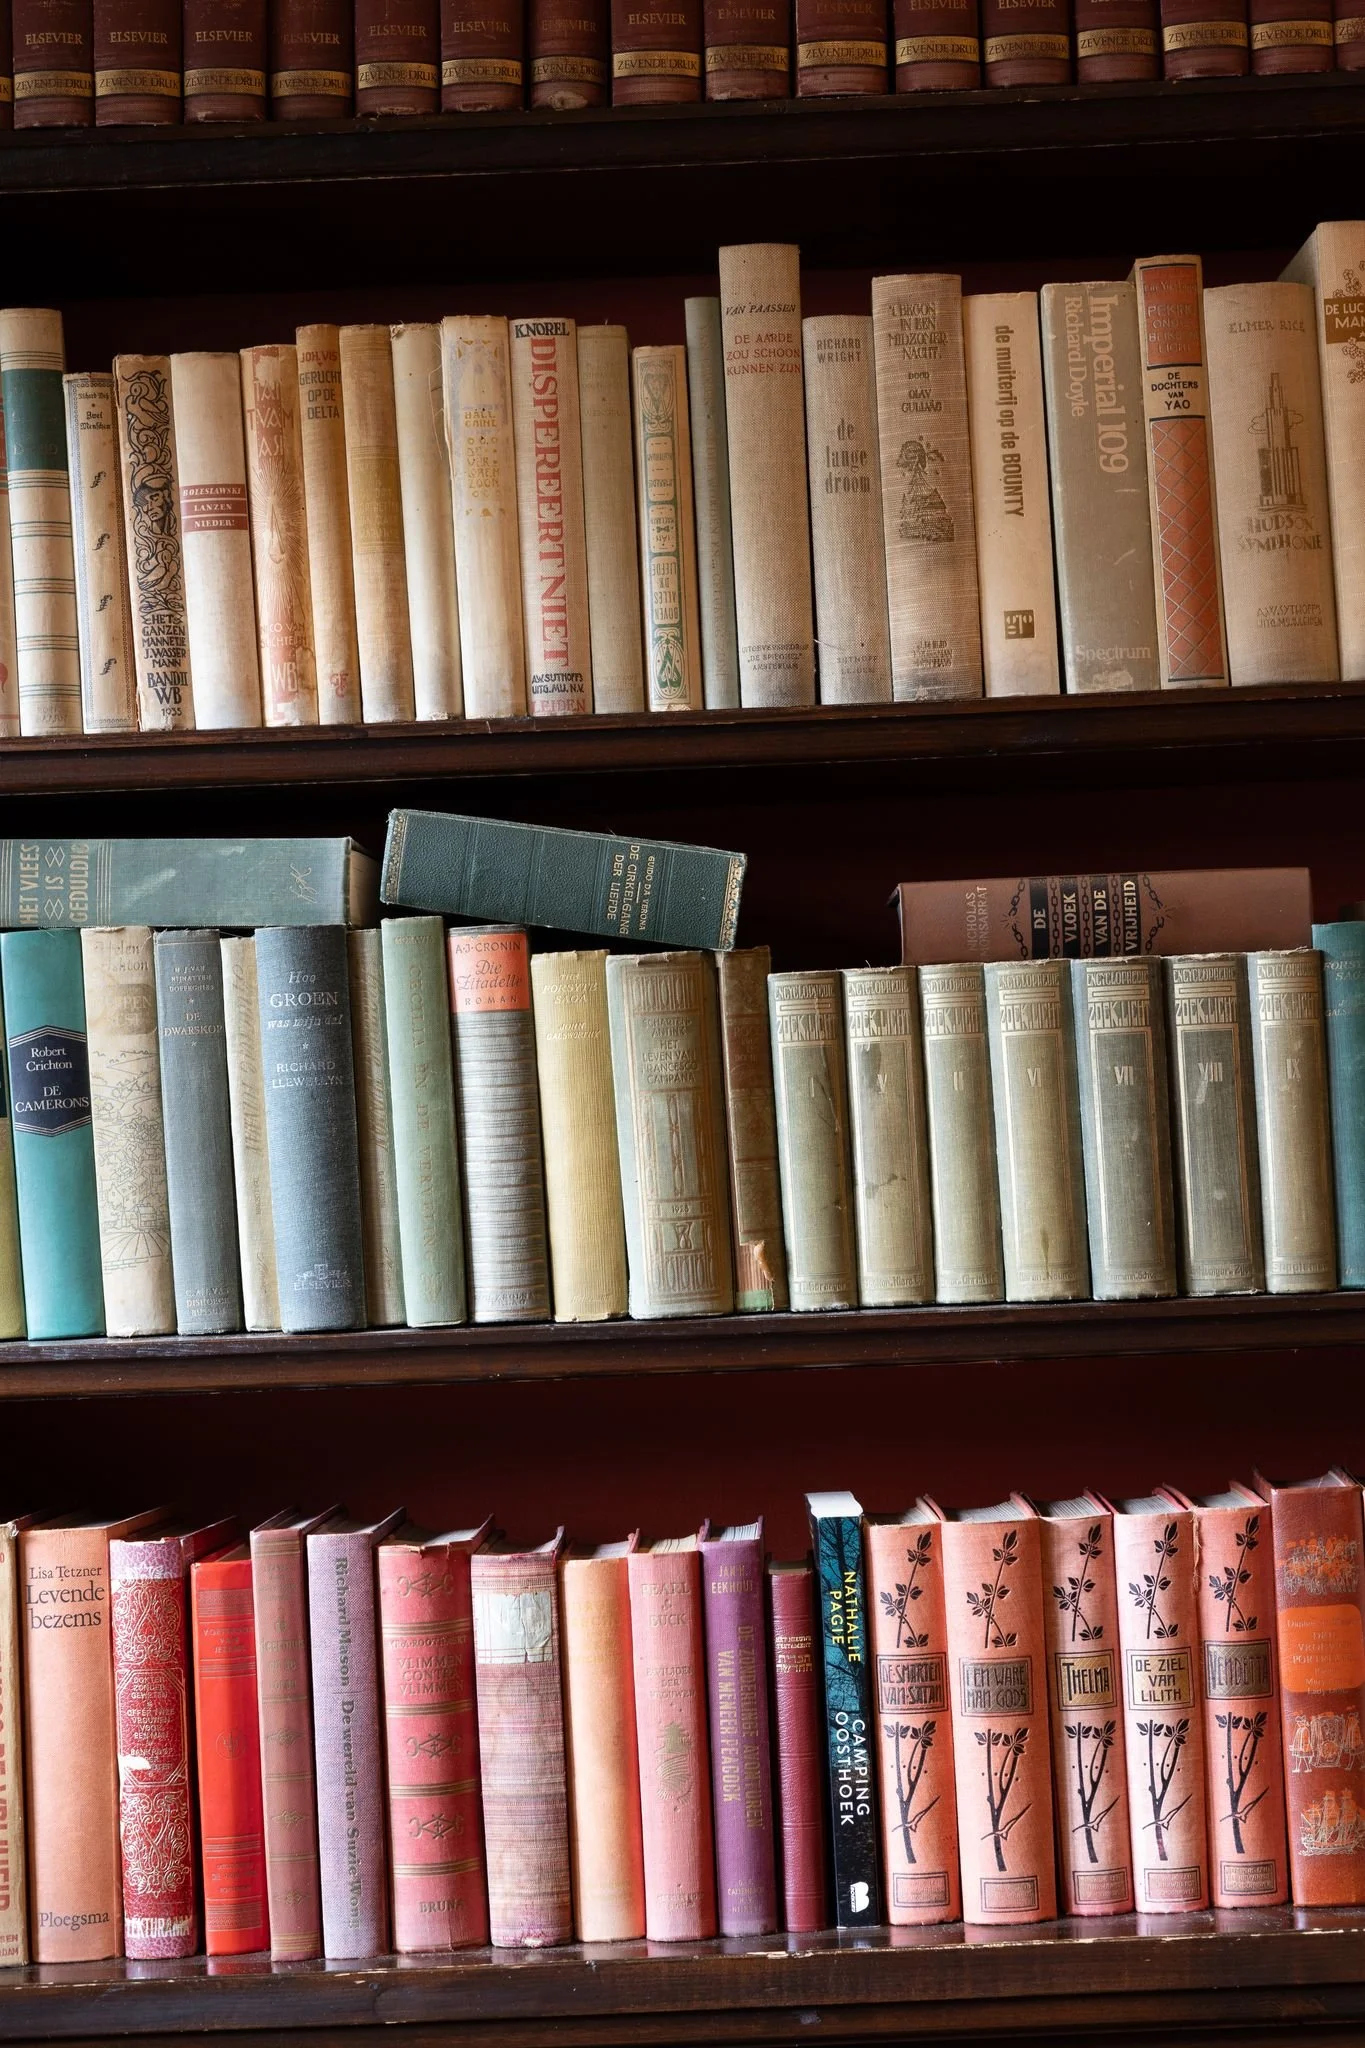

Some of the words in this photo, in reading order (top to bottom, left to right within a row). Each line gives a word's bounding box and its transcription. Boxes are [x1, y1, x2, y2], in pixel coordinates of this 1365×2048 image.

[628, 14, 686, 26] ELSEVIER
[718, 9, 776, 20] ELSEVIER
[370, 25, 427, 37] ELSEVIER
[453, 21, 511, 33] ELSEVIER
[542, 20, 596, 32] ELSEVIER
[25, 32, 82, 45] ELSEVIER
[110, 32, 167, 44] ELSEVIER
[196, 31, 253, 43] ELSEVIER
[283, 33, 340, 45] ELSEVIER
[708, 53, 756, 66] ZEVENDE
[758, 54, 786, 67] DRUK
[855, 47, 884, 59] DRUK
[443, 66, 491, 79] ZEVENDE
[493, 66, 521, 79] DRUK
[618, 58, 669, 71] ZEVENDE
[670, 59, 698, 71] DRUK
[16, 79, 62, 92] ZEVENDE
[100, 78, 149, 91] ZEVENDE
[151, 79, 178, 91] DRUK
[186, 76, 234, 90] ZEVENDE
[236, 76, 264, 88] DRUK
[360, 71, 406, 84] ZEVENDE
[409, 71, 438, 85] DRUK
[727, 304, 746, 315] VAN
[750, 303, 797, 313] PAASSEN
[1325, 304, 1340, 316] DE
[901, 318, 912, 330] IN
[1064, 295, 1087, 365] Richard
[1229, 320, 1273, 334] ELMER
[515, 323, 570, 343] KNOREL
[734, 334, 751, 344] DE
[756, 332, 793, 343] AARDE
[995, 325, 1014, 343] de
[817, 338, 861, 351] RICHARD
[726, 350, 749, 360] ZOU
[754, 348, 800, 358] SCHOON
[817, 351, 861, 363] WRIGHT
[1083, 294, 1127, 416] Imperial
[727, 364, 774, 375] KUNNEN
[779, 363, 801, 373] ZIJN
[996, 346, 1018, 405] muiterij
[1167, 372, 1181, 381] DE
[300, 371, 342, 386] GERUCHT
[1151, 381, 1199, 392] DOCHTERS
[308, 389, 321, 402] OP
[323, 388, 336, 402] DE
[1065, 366, 1089, 417] Doyle
[1168, 391, 1184, 399] VAN
[308, 405, 340, 420] DELTA
[1165, 400, 1191, 410] YAO
[247, 408, 294, 430] TVAM
[997, 409, 1015, 427] op
[837, 418, 854, 441] de
[259, 434, 284, 457] ASI
[1000, 431, 1020, 449] de
[1098, 422, 1129, 474] 109
[530, 338, 566, 571] DISPEREERT
[827, 445, 868, 469] lange
[826, 472, 871, 494] droom
[1002, 452, 1025, 517] BOUNTY
[194, 503, 233, 512] LANZEN
[195, 519, 235, 528] NIEDER!
[1248, 513, 1315, 533] HUDSON
[1239, 534, 1322, 553] SYMPHONIE
[152, 613, 174, 625] HET
[540, 572, 569, 668] NIET
[142, 625, 186, 637] GANZEN
[1075, 644, 1152, 665] Spectrum
[153, 659, 181, 669] MANN
[154, 687, 182, 705] WB
[161, 708, 182, 717] 1935
[531, 699, 587, 714] LEIDEN
[629, 844, 641, 861] DE
[20, 843, 41, 892] VLEES
[612, 854, 626, 877] DER
[645, 855, 656, 881] GUIDO
[44, 875, 65, 890] IS
[69, 843, 90, 923] GEDULDIG
[643, 883, 652, 896] DA
[606, 881, 622, 921] LIEFDE
[619, 863, 638, 935] CIRKELGANG
[1094, 889, 1106, 911] DE
[19, 894, 40, 925] HET
[638, 899, 650, 931] VERONA
[1063, 892, 1077, 944] VLOEK
[1122, 880, 1139, 951] VRIJHEID
[966, 892, 977, 952] NICHOLAS
[1032, 908, 1047, 930] DE
[1095, 915, 1108, 946] VAN
[475, 959, 502, 976] Die
[288, 970, 317, 984] Hoe
[269, 991, 339, 1008] GROEN
[408, 964, 427, 1048] CECILIA
[185, 1012, 201, 1022] DE
[267, 1018, 290, 1031] was
[31, 1046, 68, 1058] Robert
[660, 1039, 678, 1051] HET
[643, 1050, 673, 1063] LEVEN
[26, 1060, 73, 1072] Crichton
[276, 1060, 336, 1073] RICHARD
[1198, 1062, 1223, 1083] VIII
[1286, 1058, 1301, 1080] IX
[877, 1073, 888, 1095] V
[952, 1070, 964, 1091] II
[1026, 1067, 1041, 1088] VI
[1114, 1065, 1134, 1086] VII
[43, 1085, 62, 1097] DE
[810, 1076, 815, 1098] I
[15, 1097, 90, 1113] CAMERONS
[415, 1102, 431, 1130] DE
[29, 1567, 54, 1580] Lisa
[56, 1565, 103, 1580] Tetzner
[719, 1564, 738, 1578] JAN
[25, 1580, 105, 1605] Levende
[335, 1556, 350, 1626] Richard
[641, 1582, 691, 1598] PEARL
[31, 1608, 102, 1630] bezems
[649, 1613, 687, 1628] BUCK
[829, 1590, 845, 1645] PAGIE
[843, 1571, 861, 1663] NATHALIE
[338, 1630, 351, 1688] Mason
[398, 1655, 463, 1670] VLIMMEN
[717, 1649, 736, 1678] VAN
[1135, 1659, 1151, 1672] DE
[1158, 1657, 1186, 1671] ZIEL
[661, 1679, 682, 1688] DER
[1148, 1673, 1177, 1687] VAN
[400, 1681, 464, 1697] VLIMMEN
[996, 1687, 1027, 1708] GODS
[1141, 1688, 1182, 1703] LILITH
[341, 1700, 355, 1728] De
[718, 1681, 739, 1736] MENEER
[342, 1729, 357, 1790] wereld
[852, 1719, 870, 1817] CAMPING
[720, 1738, 742, 1803] PEACOCK
[835, 1711, 855, 1826] OOSTHOEK
[344, 1793, 357, 1825] van
[345, 1827, 361, 1876] Suzie
[346, 1878, 363, 1934] Wong
[39, 1911, 110, 1931] Ploegsma
